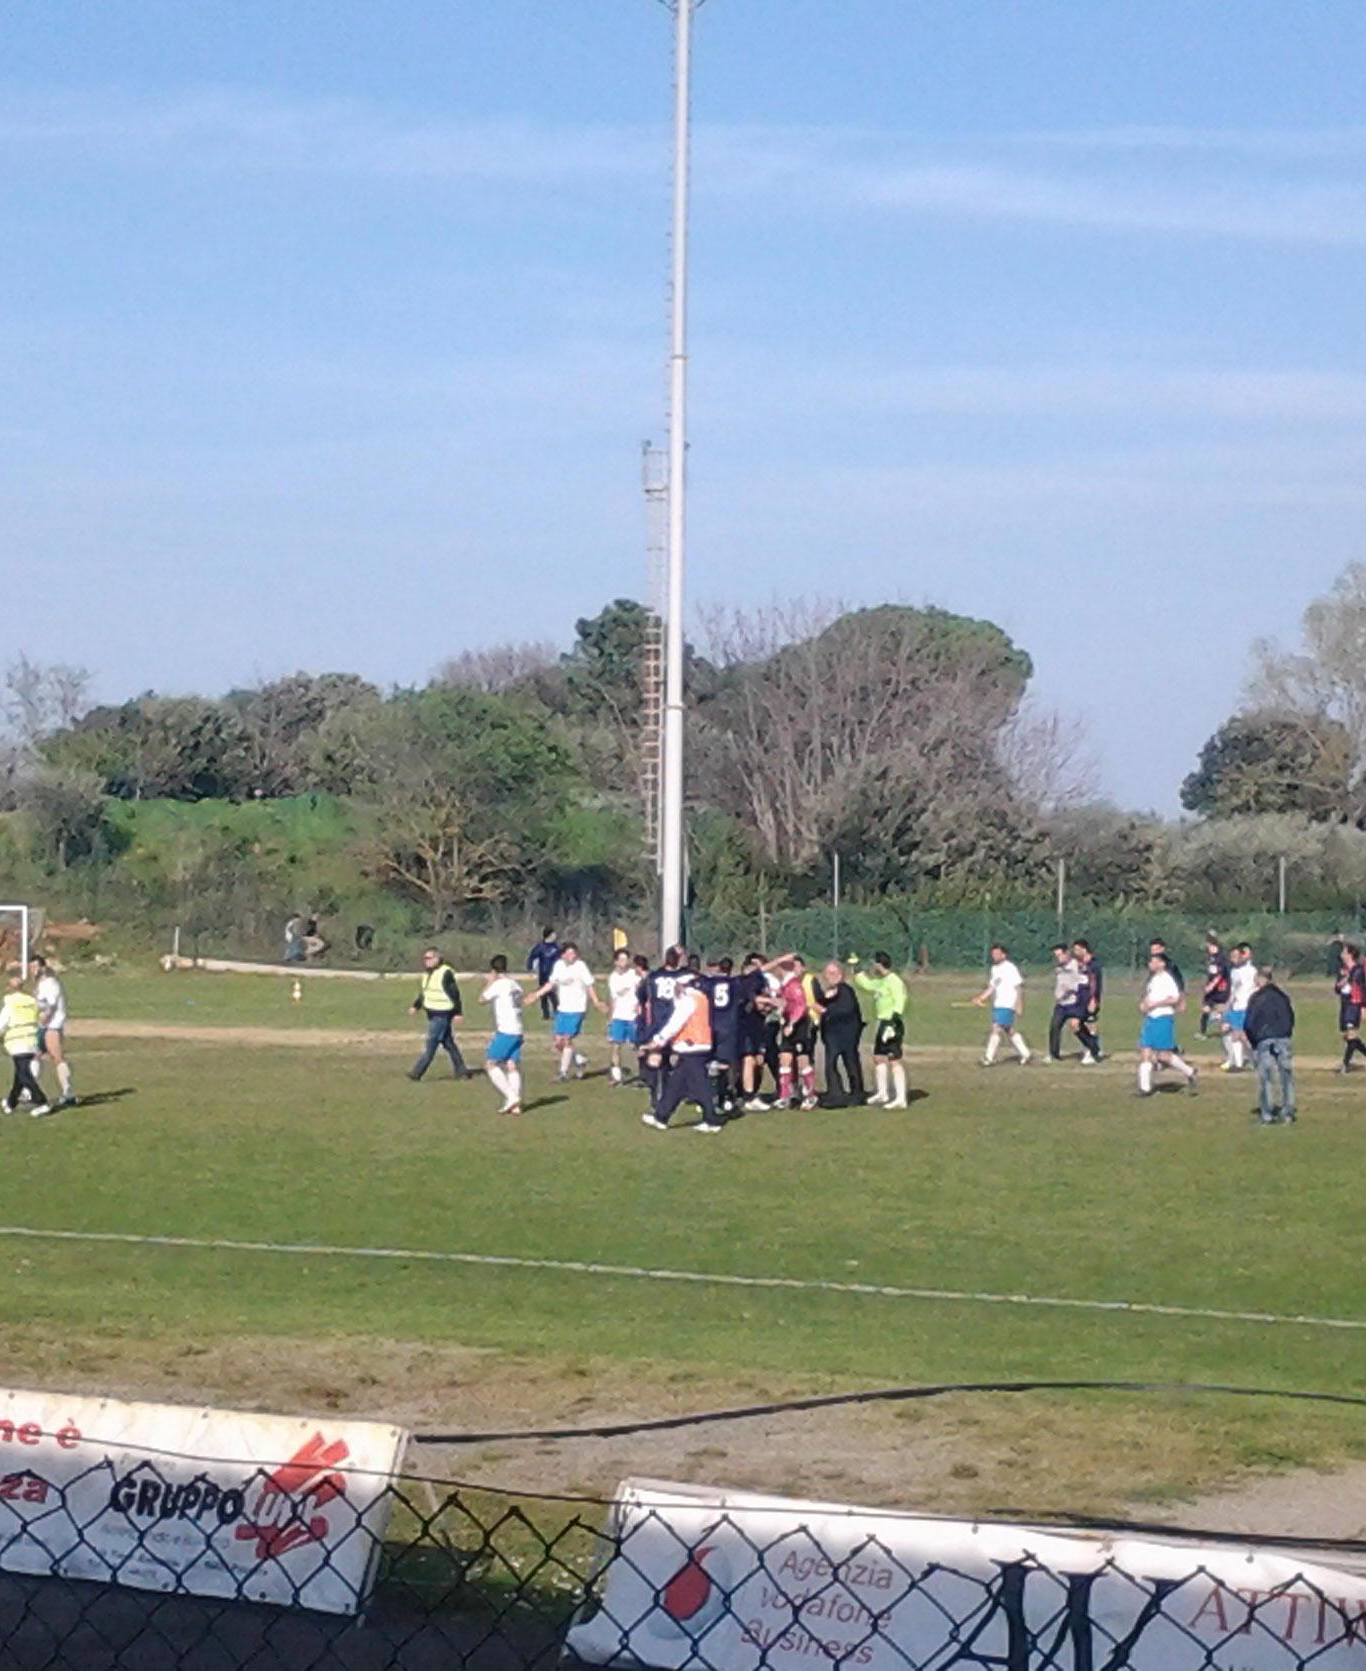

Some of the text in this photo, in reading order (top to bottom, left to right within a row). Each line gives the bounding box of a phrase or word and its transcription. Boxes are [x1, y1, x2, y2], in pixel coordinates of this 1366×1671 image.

[56, 1418, 81, 1449] è
[111, 1478, 244, 1525] GRUPPO
[777, 1550, 893, 1590] Agenzia
[740, 1618, 875, 1665] Business
